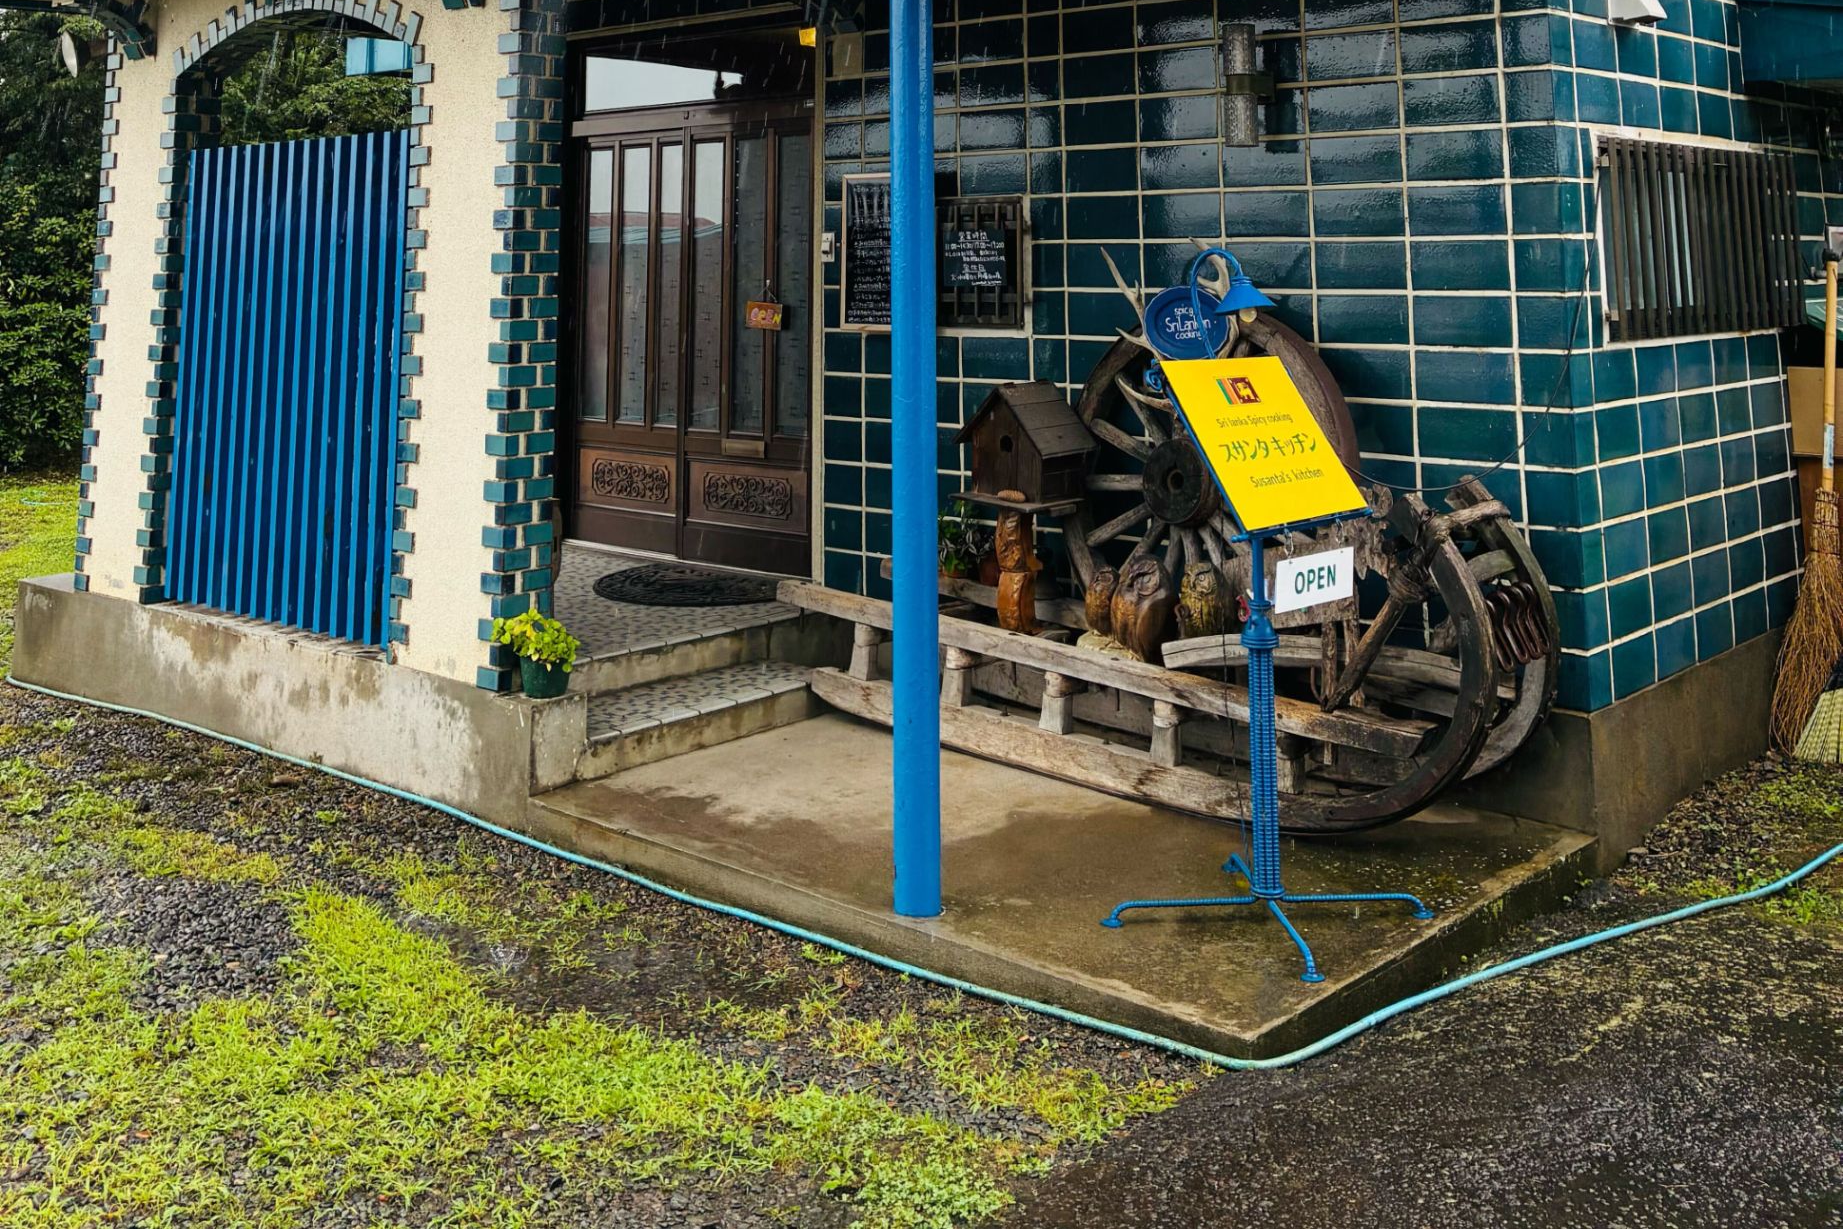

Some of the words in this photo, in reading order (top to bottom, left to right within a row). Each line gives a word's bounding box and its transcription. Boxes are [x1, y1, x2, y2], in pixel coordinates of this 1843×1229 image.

[1216, 418, 1230, 428] Sri
[1267, 412, 1294, 423] cooking
[1250, 471, 1293, 487] Susanta's
[1291, 468, 1324, 481] kitchen
[1295, 564, 1336, 594] OPEN
